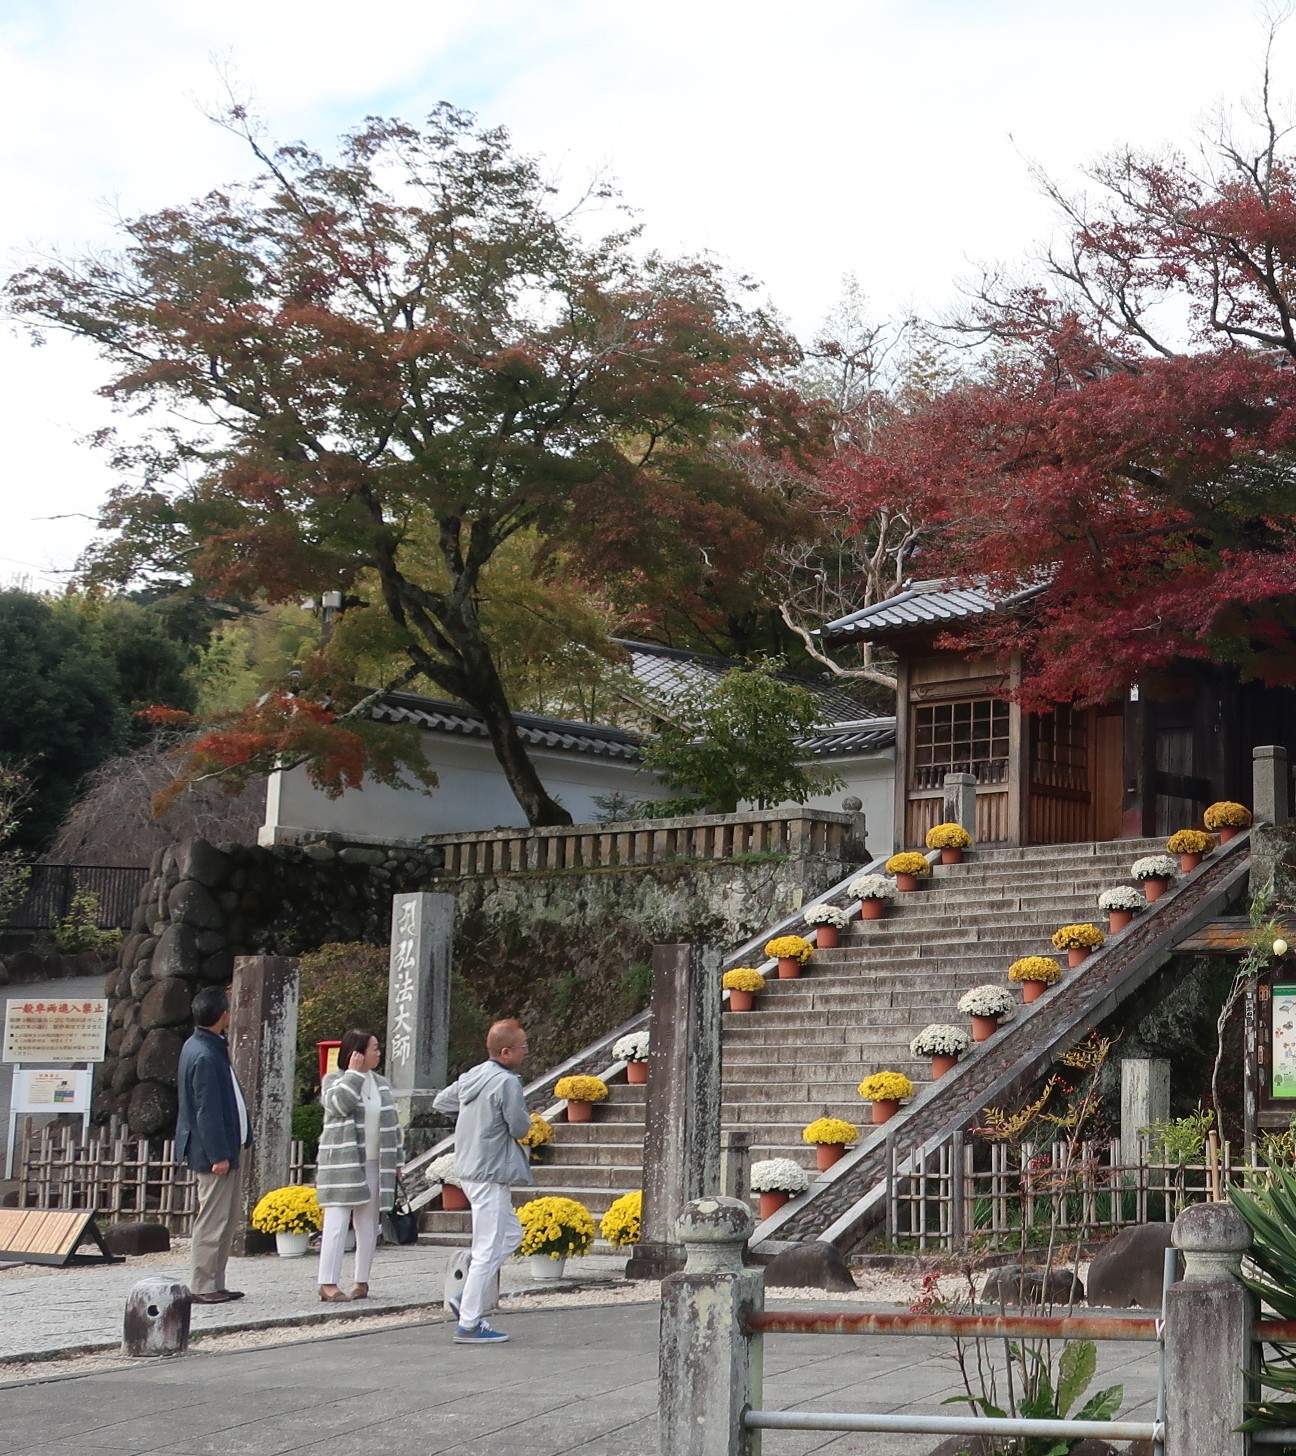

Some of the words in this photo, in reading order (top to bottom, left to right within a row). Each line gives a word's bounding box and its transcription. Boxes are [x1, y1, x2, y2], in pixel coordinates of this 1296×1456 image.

[11, 1002, 105, 1015] 一般車両進入禁止
